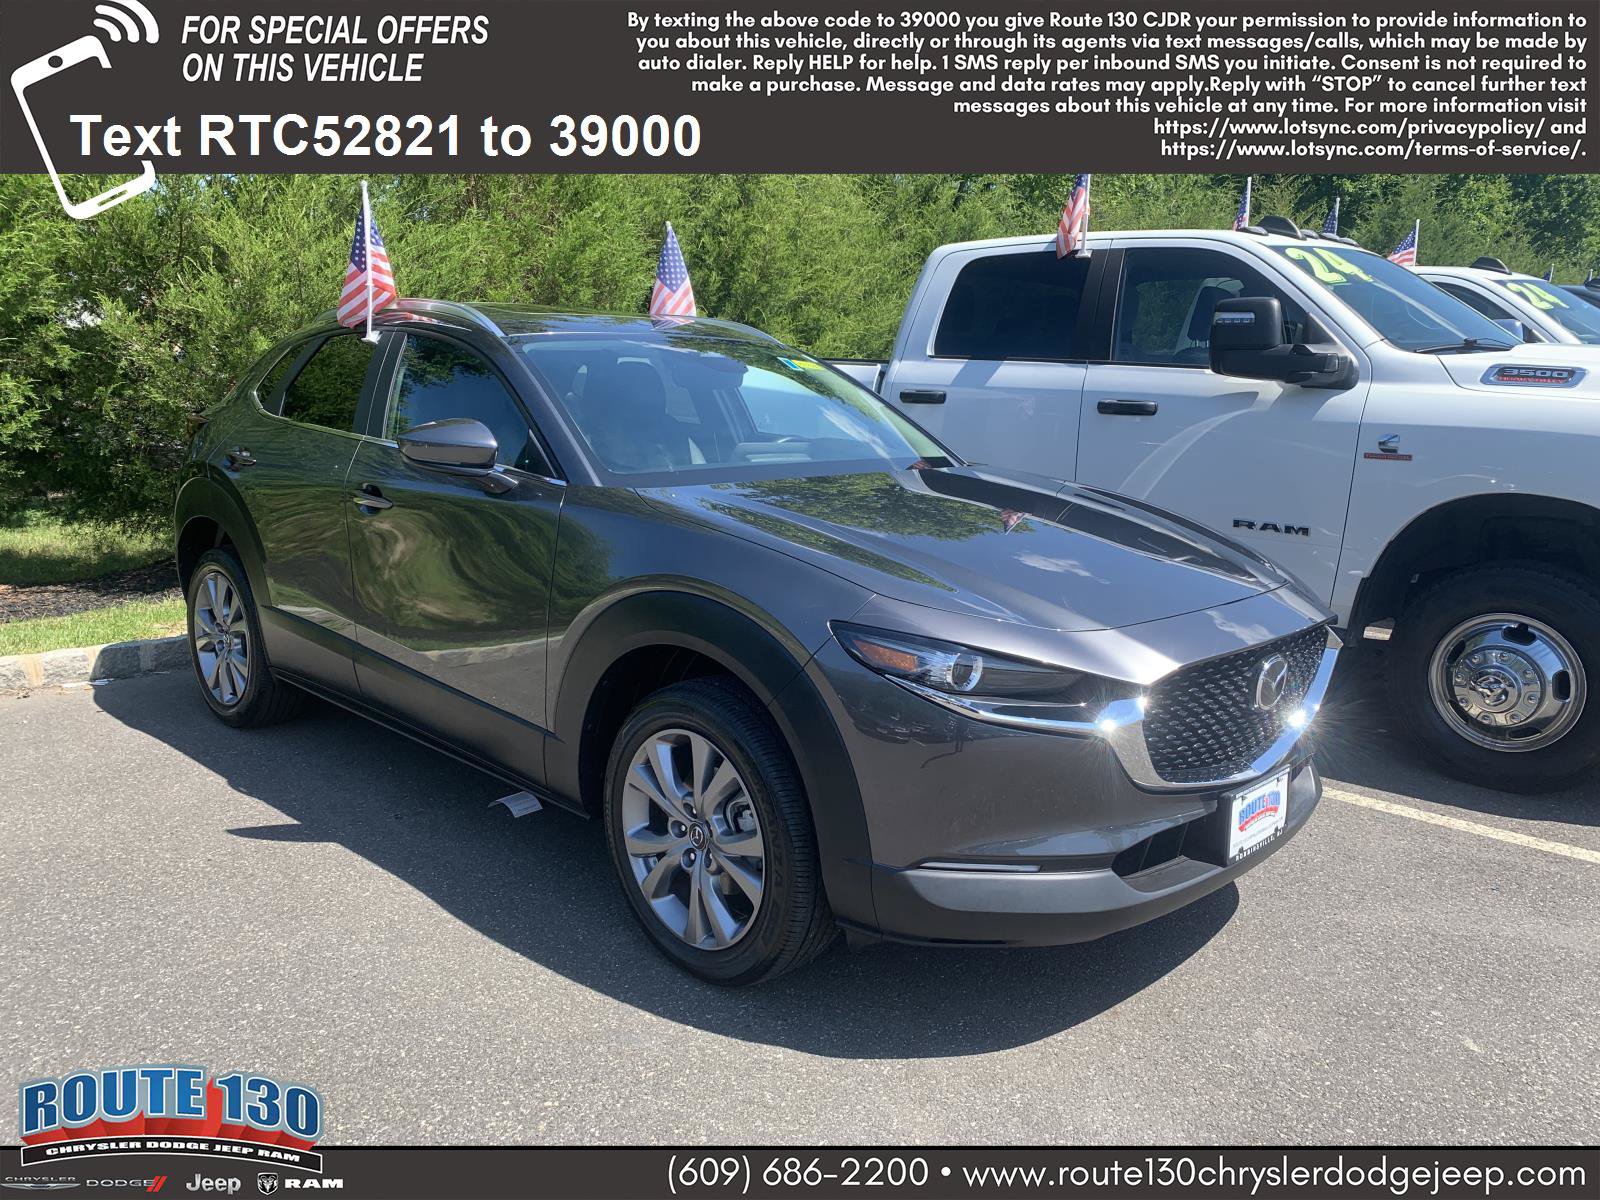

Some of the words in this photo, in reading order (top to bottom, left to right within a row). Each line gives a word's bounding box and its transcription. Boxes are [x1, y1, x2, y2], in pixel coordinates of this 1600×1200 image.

[1285, 247, 1373, 283] 24
[1503, 368, 1568, 378] 3500
[1233, 519, 1310, 536] RAM
